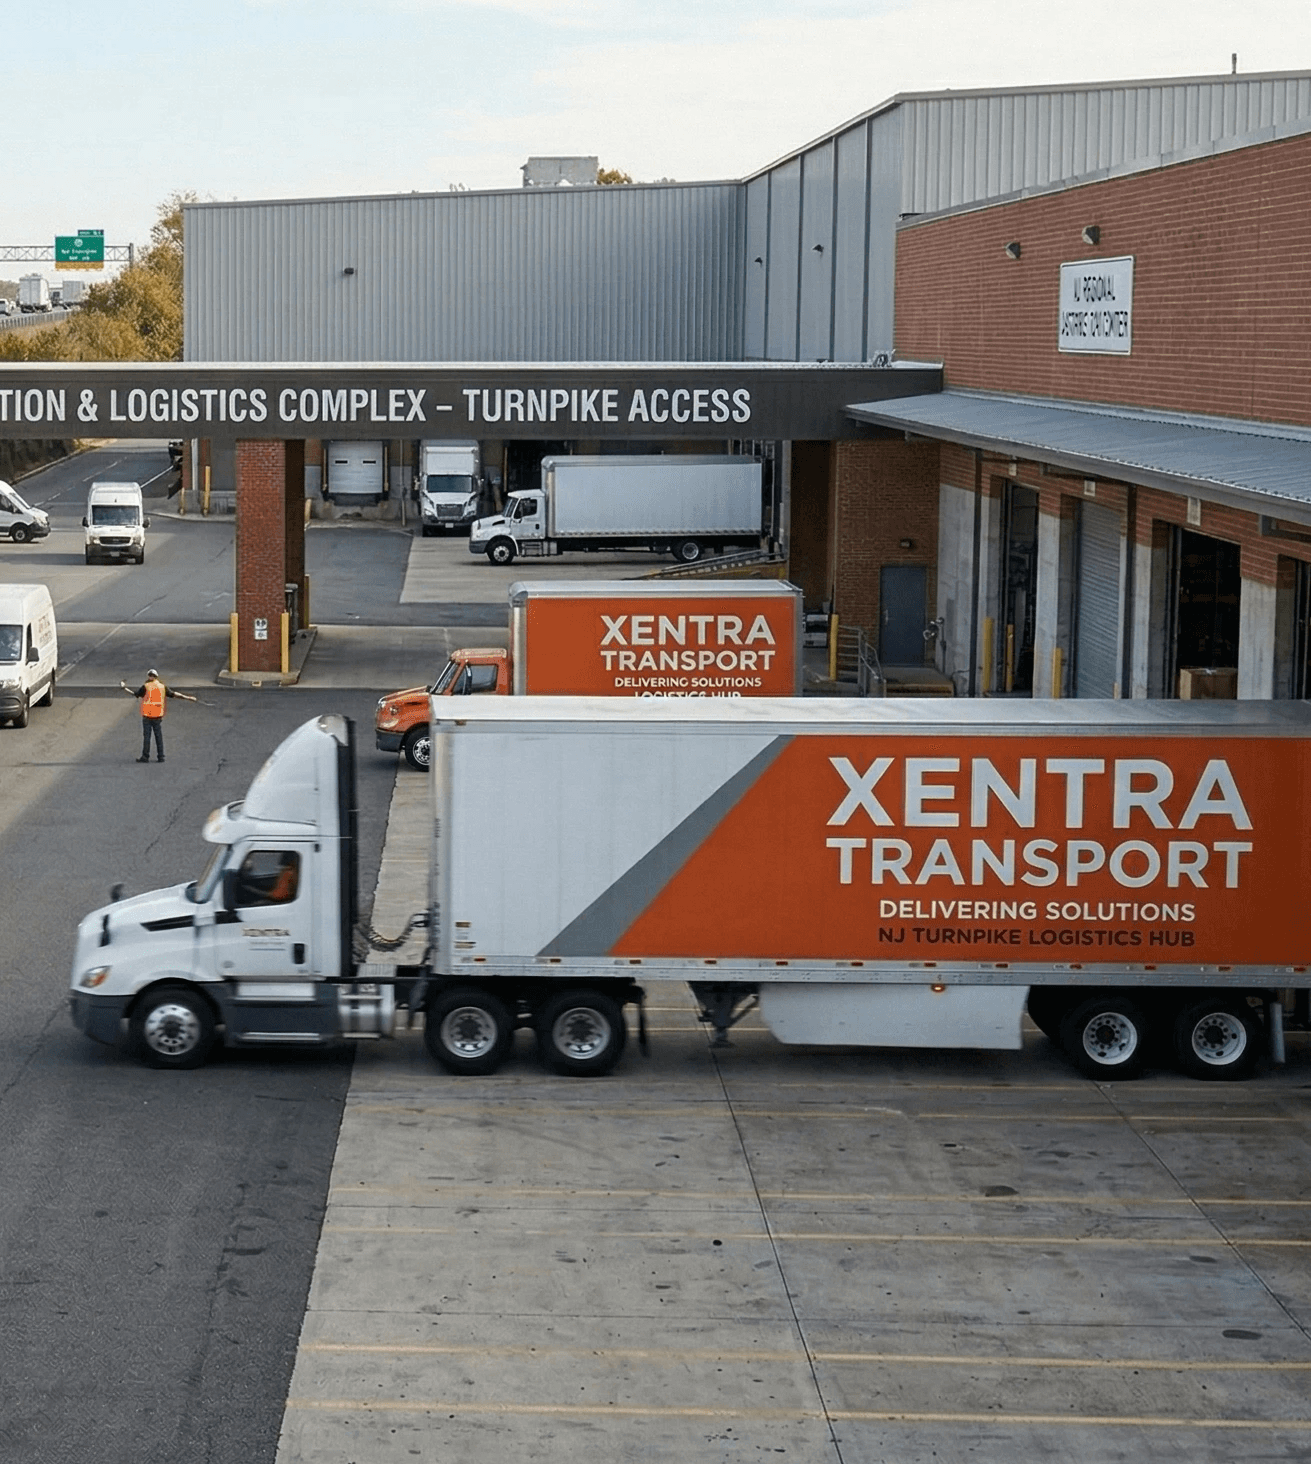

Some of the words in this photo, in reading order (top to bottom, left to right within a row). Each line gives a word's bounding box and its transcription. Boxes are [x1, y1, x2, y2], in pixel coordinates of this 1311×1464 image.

[77, 388, 99, 422] &
[110, 388, 268, 423] LOGISTICS
[279, 388, 427, 422] COMPLEX
[462, 388, 619, 422] TURNPIKE
[627, 388, 751, 423] ACCESS
[600, 614, 776, 646] XENTRA
[600, 650, 776, 671] TRANSPORT
[614, 677, 688, 688] DELIVERING
[691, 677, 762, 687] SOLUTIONS
[826, 756, 1254, 830] XENTRA
[826, 837, 1254, 888] TRANSPORT
[879, 899, 1037, 920] DELIVERING
[1045, 901, 1196, 921] SOLUTIONS
[879, 927, 905, 943] NJ
[912, 928, 1022, 945] TURNPIKE
[1029, 929, 1142, 947] LOGISTICS
[1149, 930, 1196, 947] HUB
